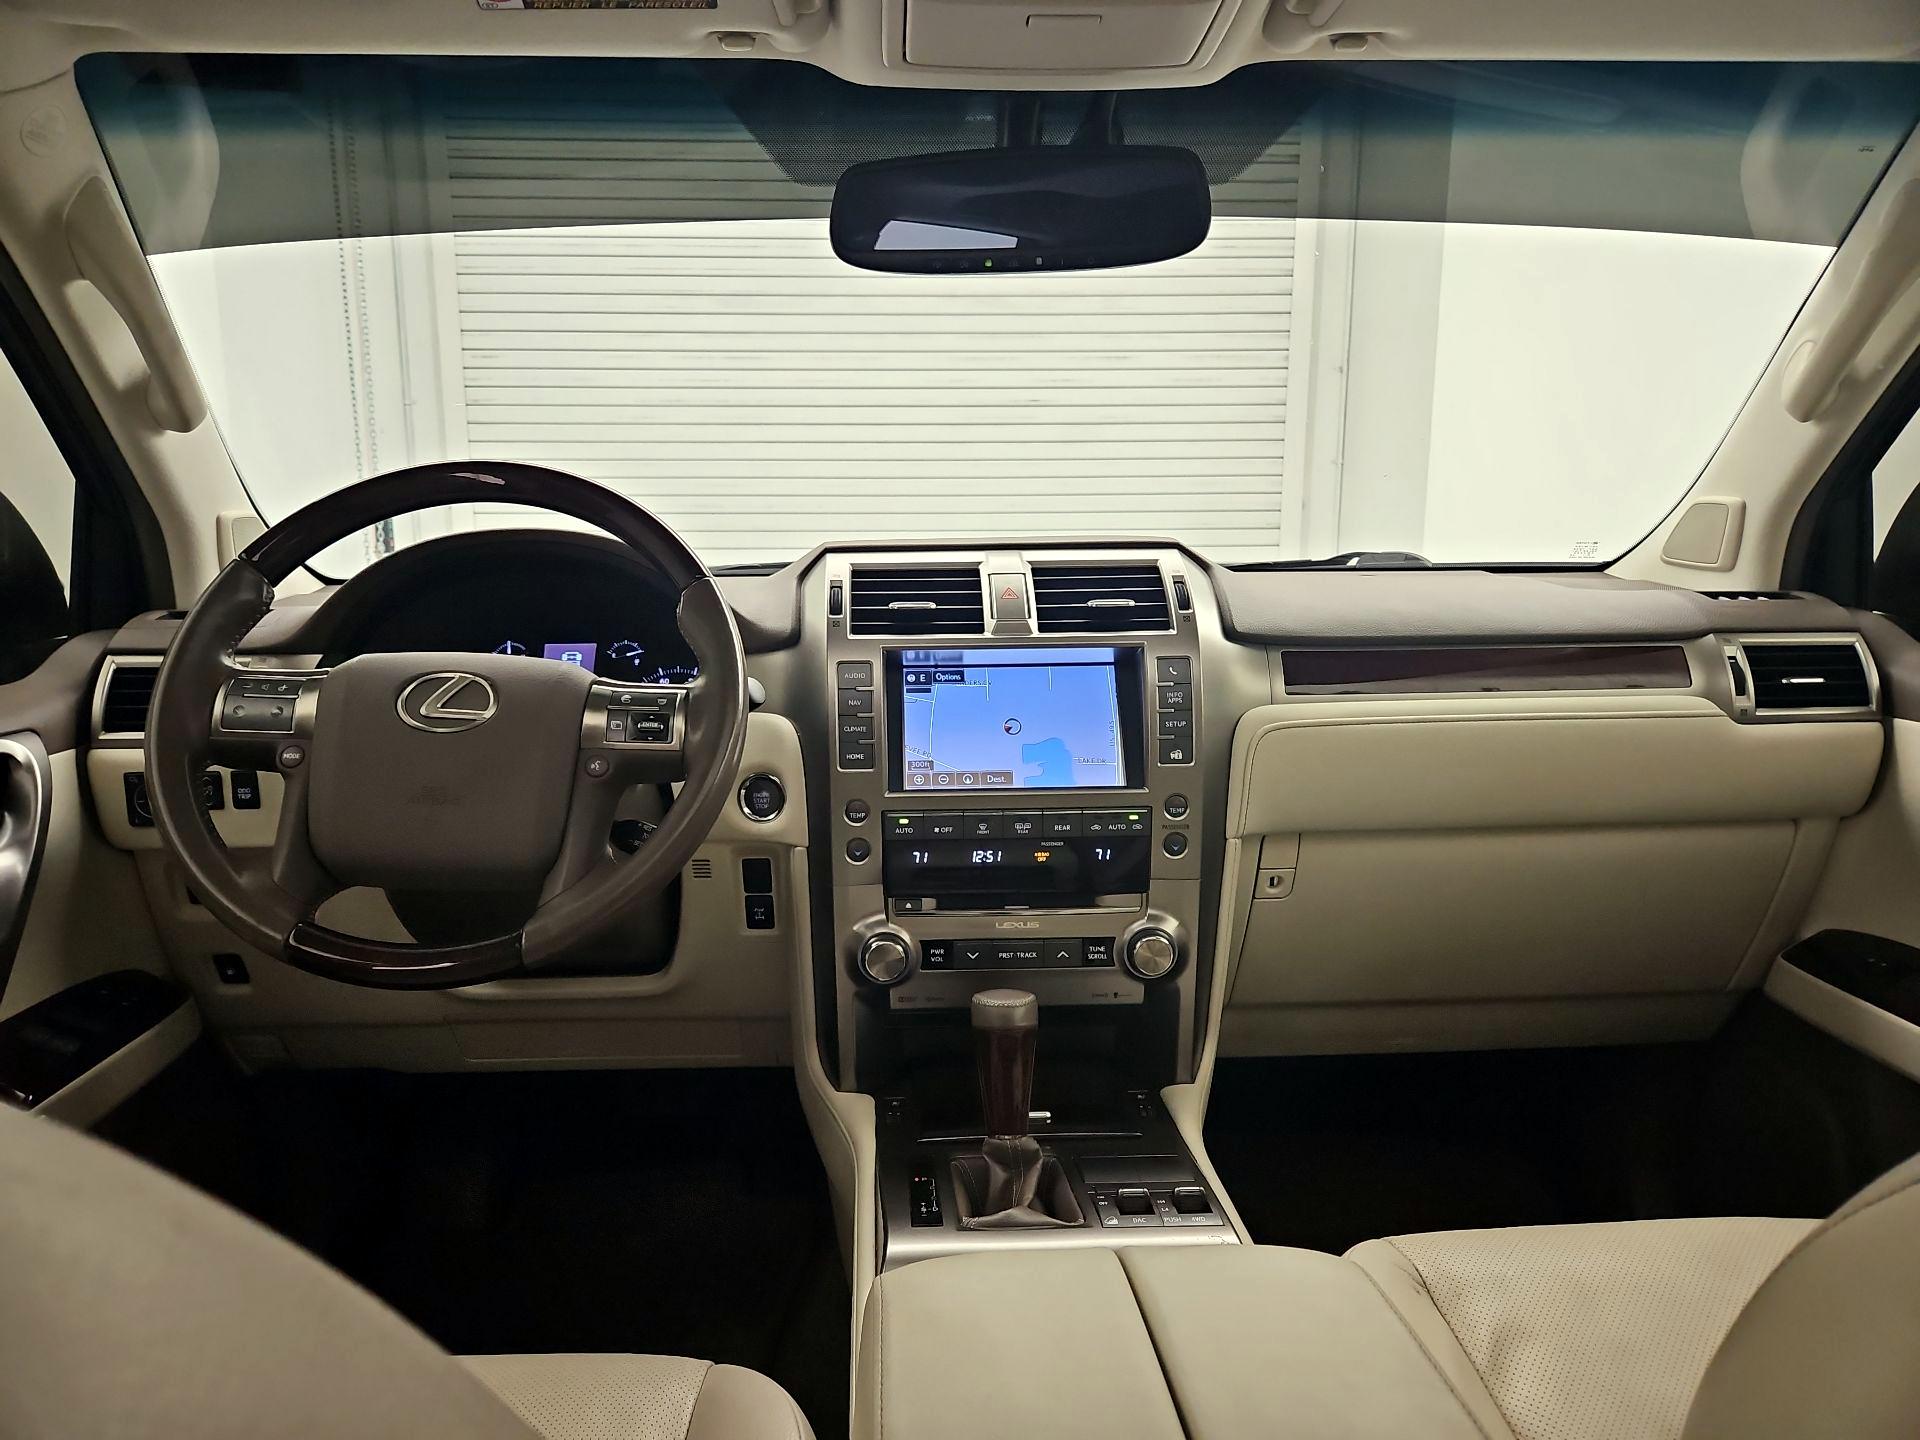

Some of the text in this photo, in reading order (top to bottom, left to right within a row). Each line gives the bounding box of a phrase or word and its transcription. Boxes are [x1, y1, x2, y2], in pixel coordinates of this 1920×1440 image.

[920, 672, 962, 682] E Options
[987, 774, 1007, 783] Dest.
[972, 850, 1002, 863] 12:51
[995, 921, 1040, 929] LEXUS
